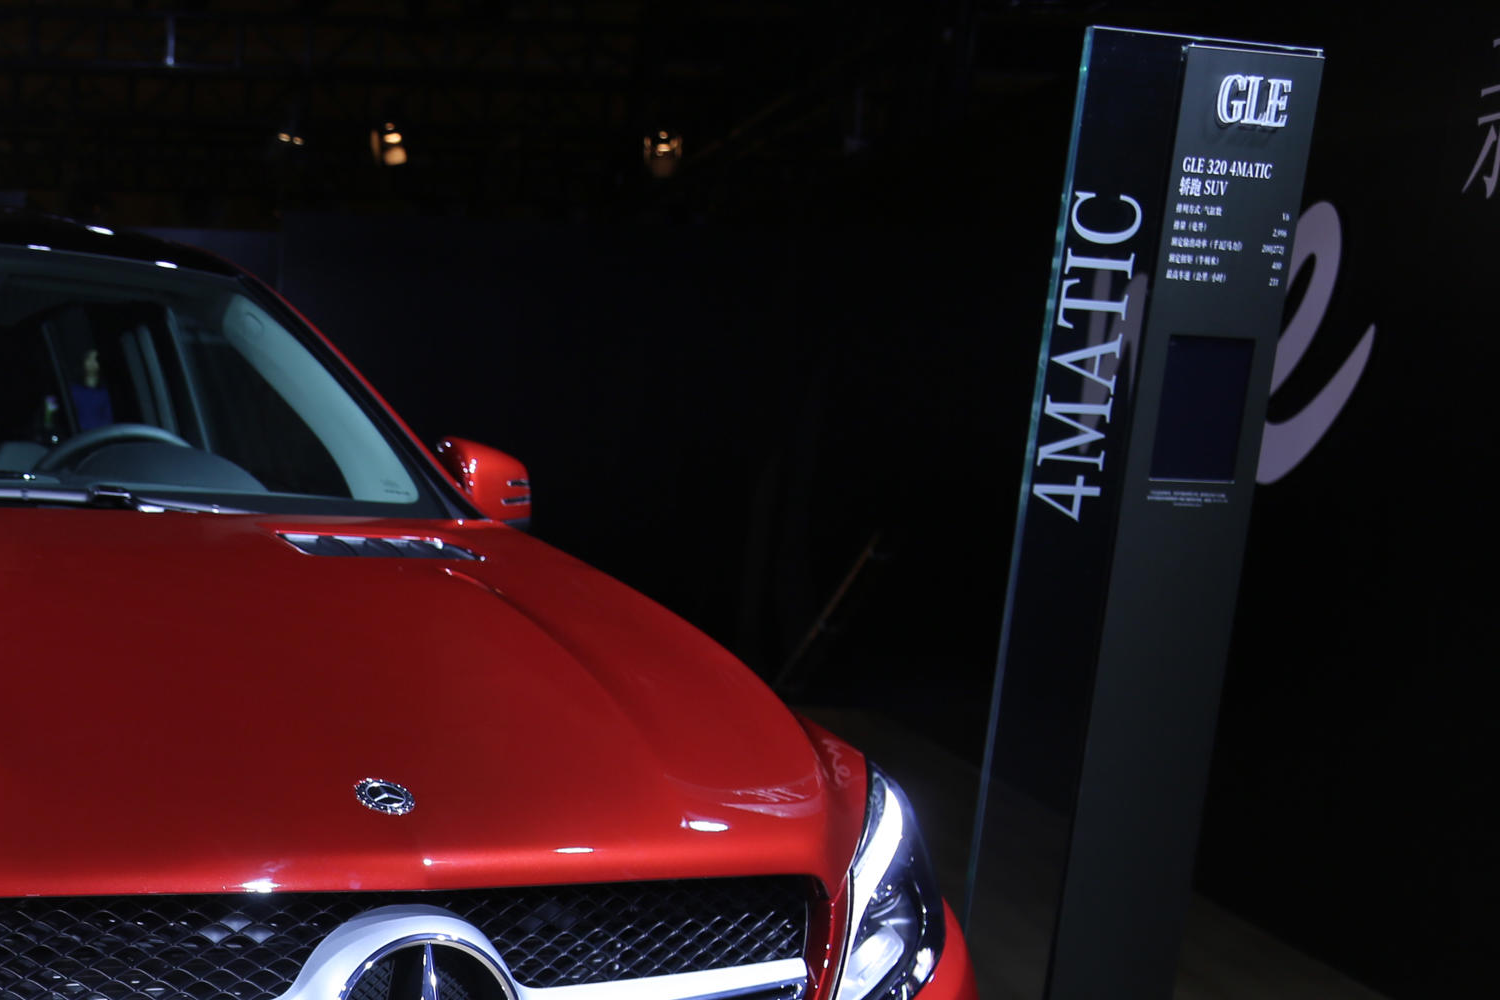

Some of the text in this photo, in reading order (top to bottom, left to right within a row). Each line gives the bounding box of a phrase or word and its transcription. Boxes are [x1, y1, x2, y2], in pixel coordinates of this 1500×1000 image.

[1216, 74, 1293, 128] GLE
[1178, 176, 1229, 197] 轿跑 SUV
[1182, 156, 1274, 180] GLE 320 4MATIC
[1032, 190, 1143, 522] 4MATIC
